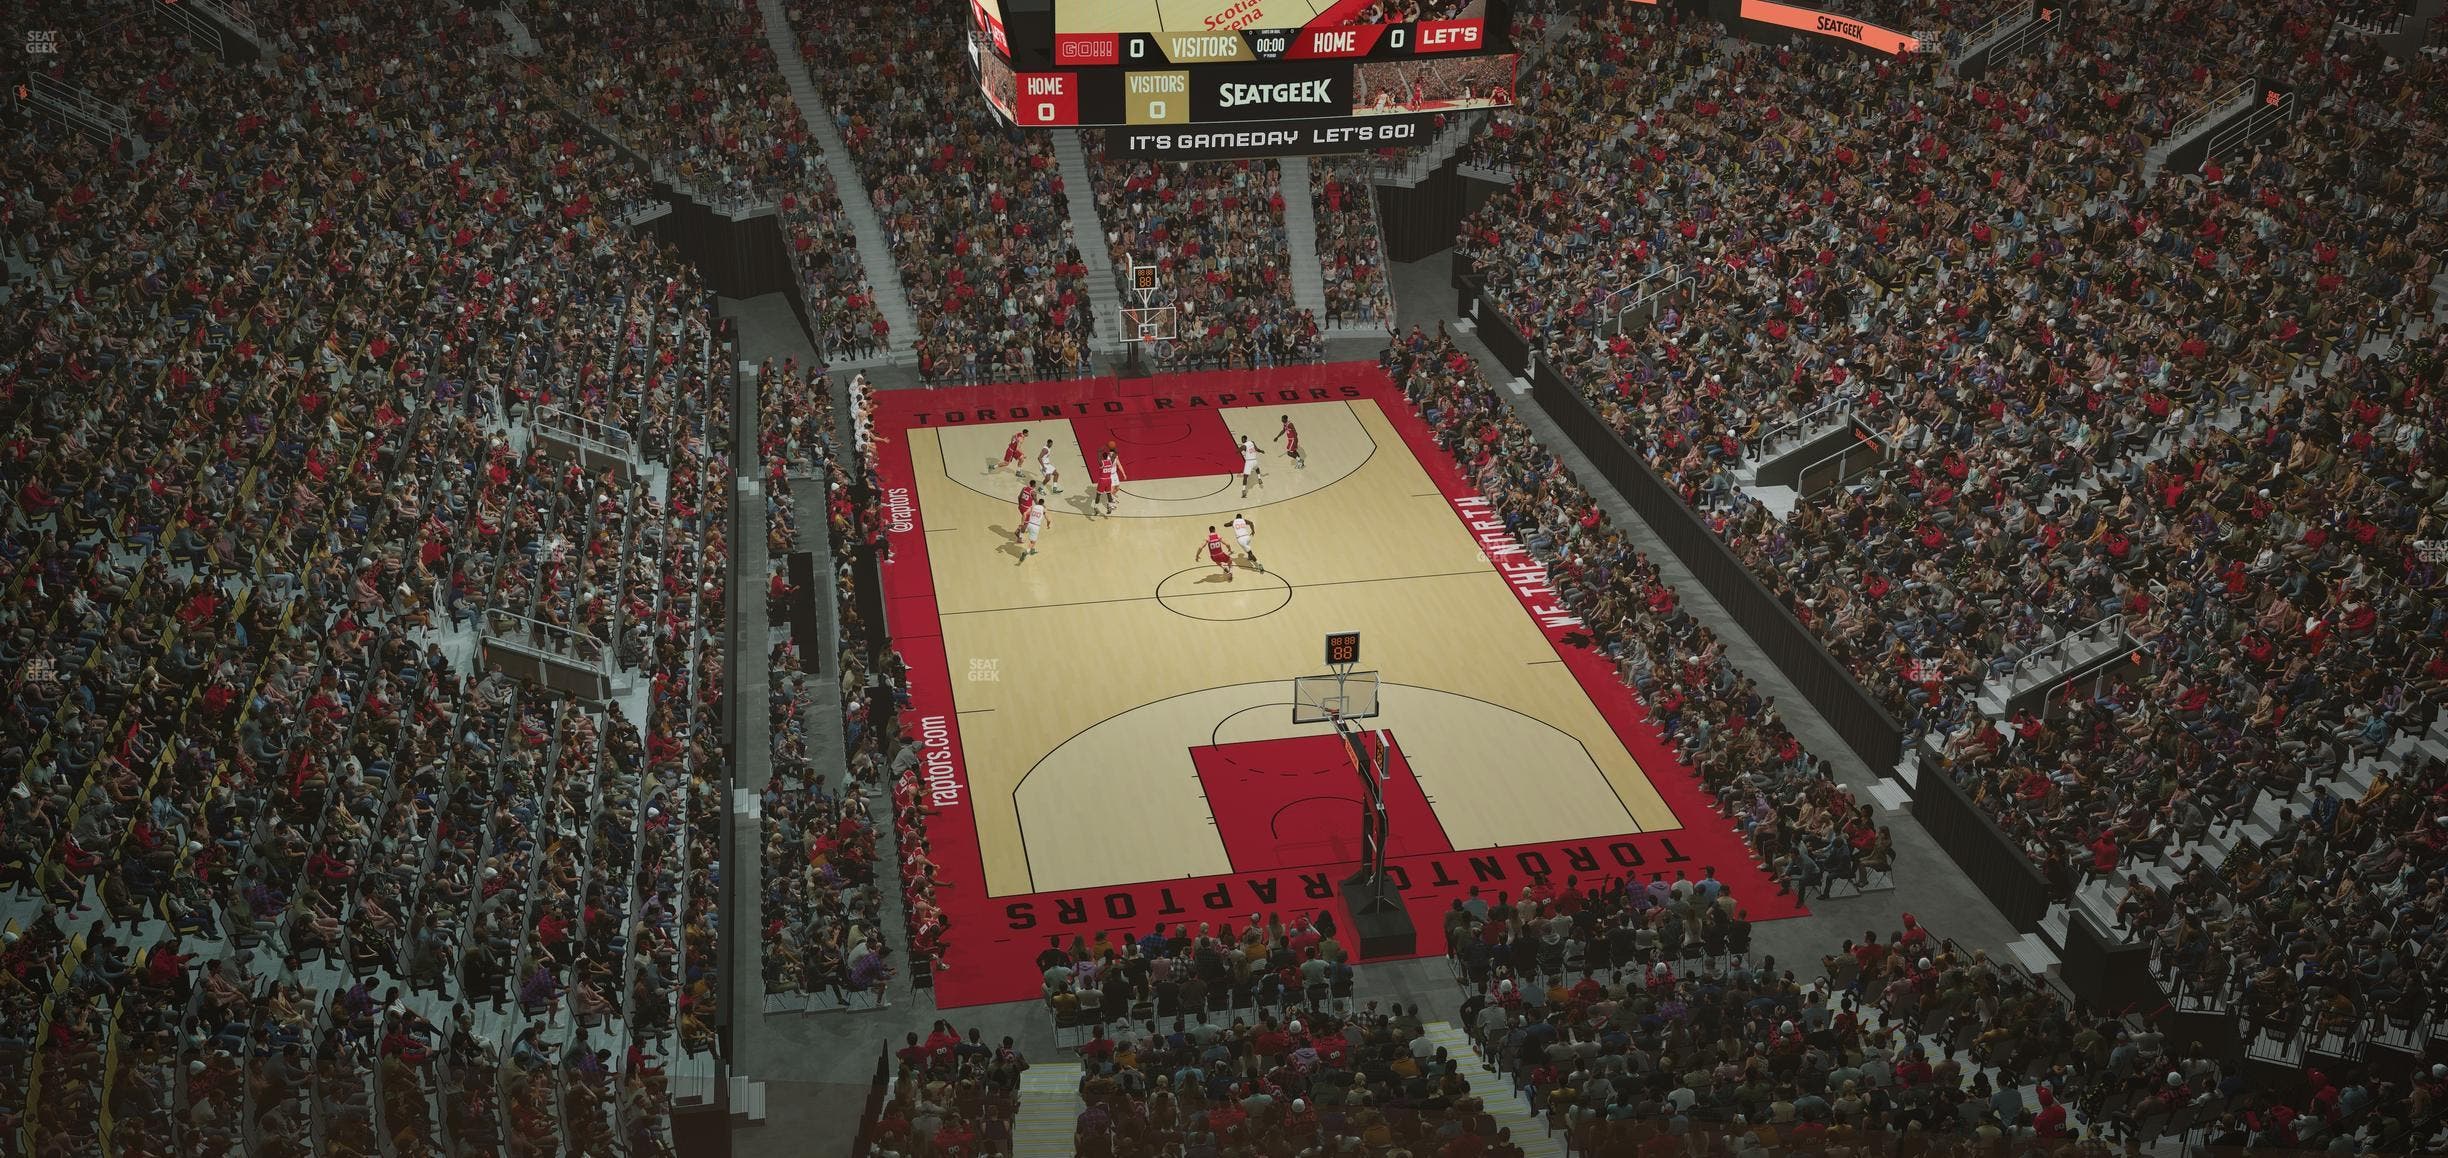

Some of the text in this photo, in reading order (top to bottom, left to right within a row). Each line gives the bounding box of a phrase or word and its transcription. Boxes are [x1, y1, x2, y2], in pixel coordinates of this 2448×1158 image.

[1223, 7, 1263, 31] rena
[1817, 15, 1864, 41] SEATGEEK
[1172, 36, 1238, 58] VISITORS
[1256, 38, 1285, 52] 00:00
[1313, 31, 1356, 53] HOME
[1390, 29, 1405, 49] 0
[1423, 27, 1478, 45] LET'S
[1062, 41, 1112, 57] GO!!!
[1130, 39, 1144, 58] 0
[1027, 77, 1063, 95] HOME
[1129, 75, 1185, 93] VISITORS
[1219, 78, 1332, 108] SEATGEEK
[1038, 103, 1055, 121] 0
[1150, 101, 1166, 119] 0
[1130, 123, 1415, 150] IT'S GAMEDAY LET'S GO!
[914, 386, 1360, 424] TORONTO RAPTORS
[888, 487, 916, 533] @raptors
[1454, 495, 1583, 628] WE THE NORTH
[1333, 646, 1352, 660] 88
[921, 715, 964, 807] raptors.com
[1006, 872, 1334, 930] RAPTORS
